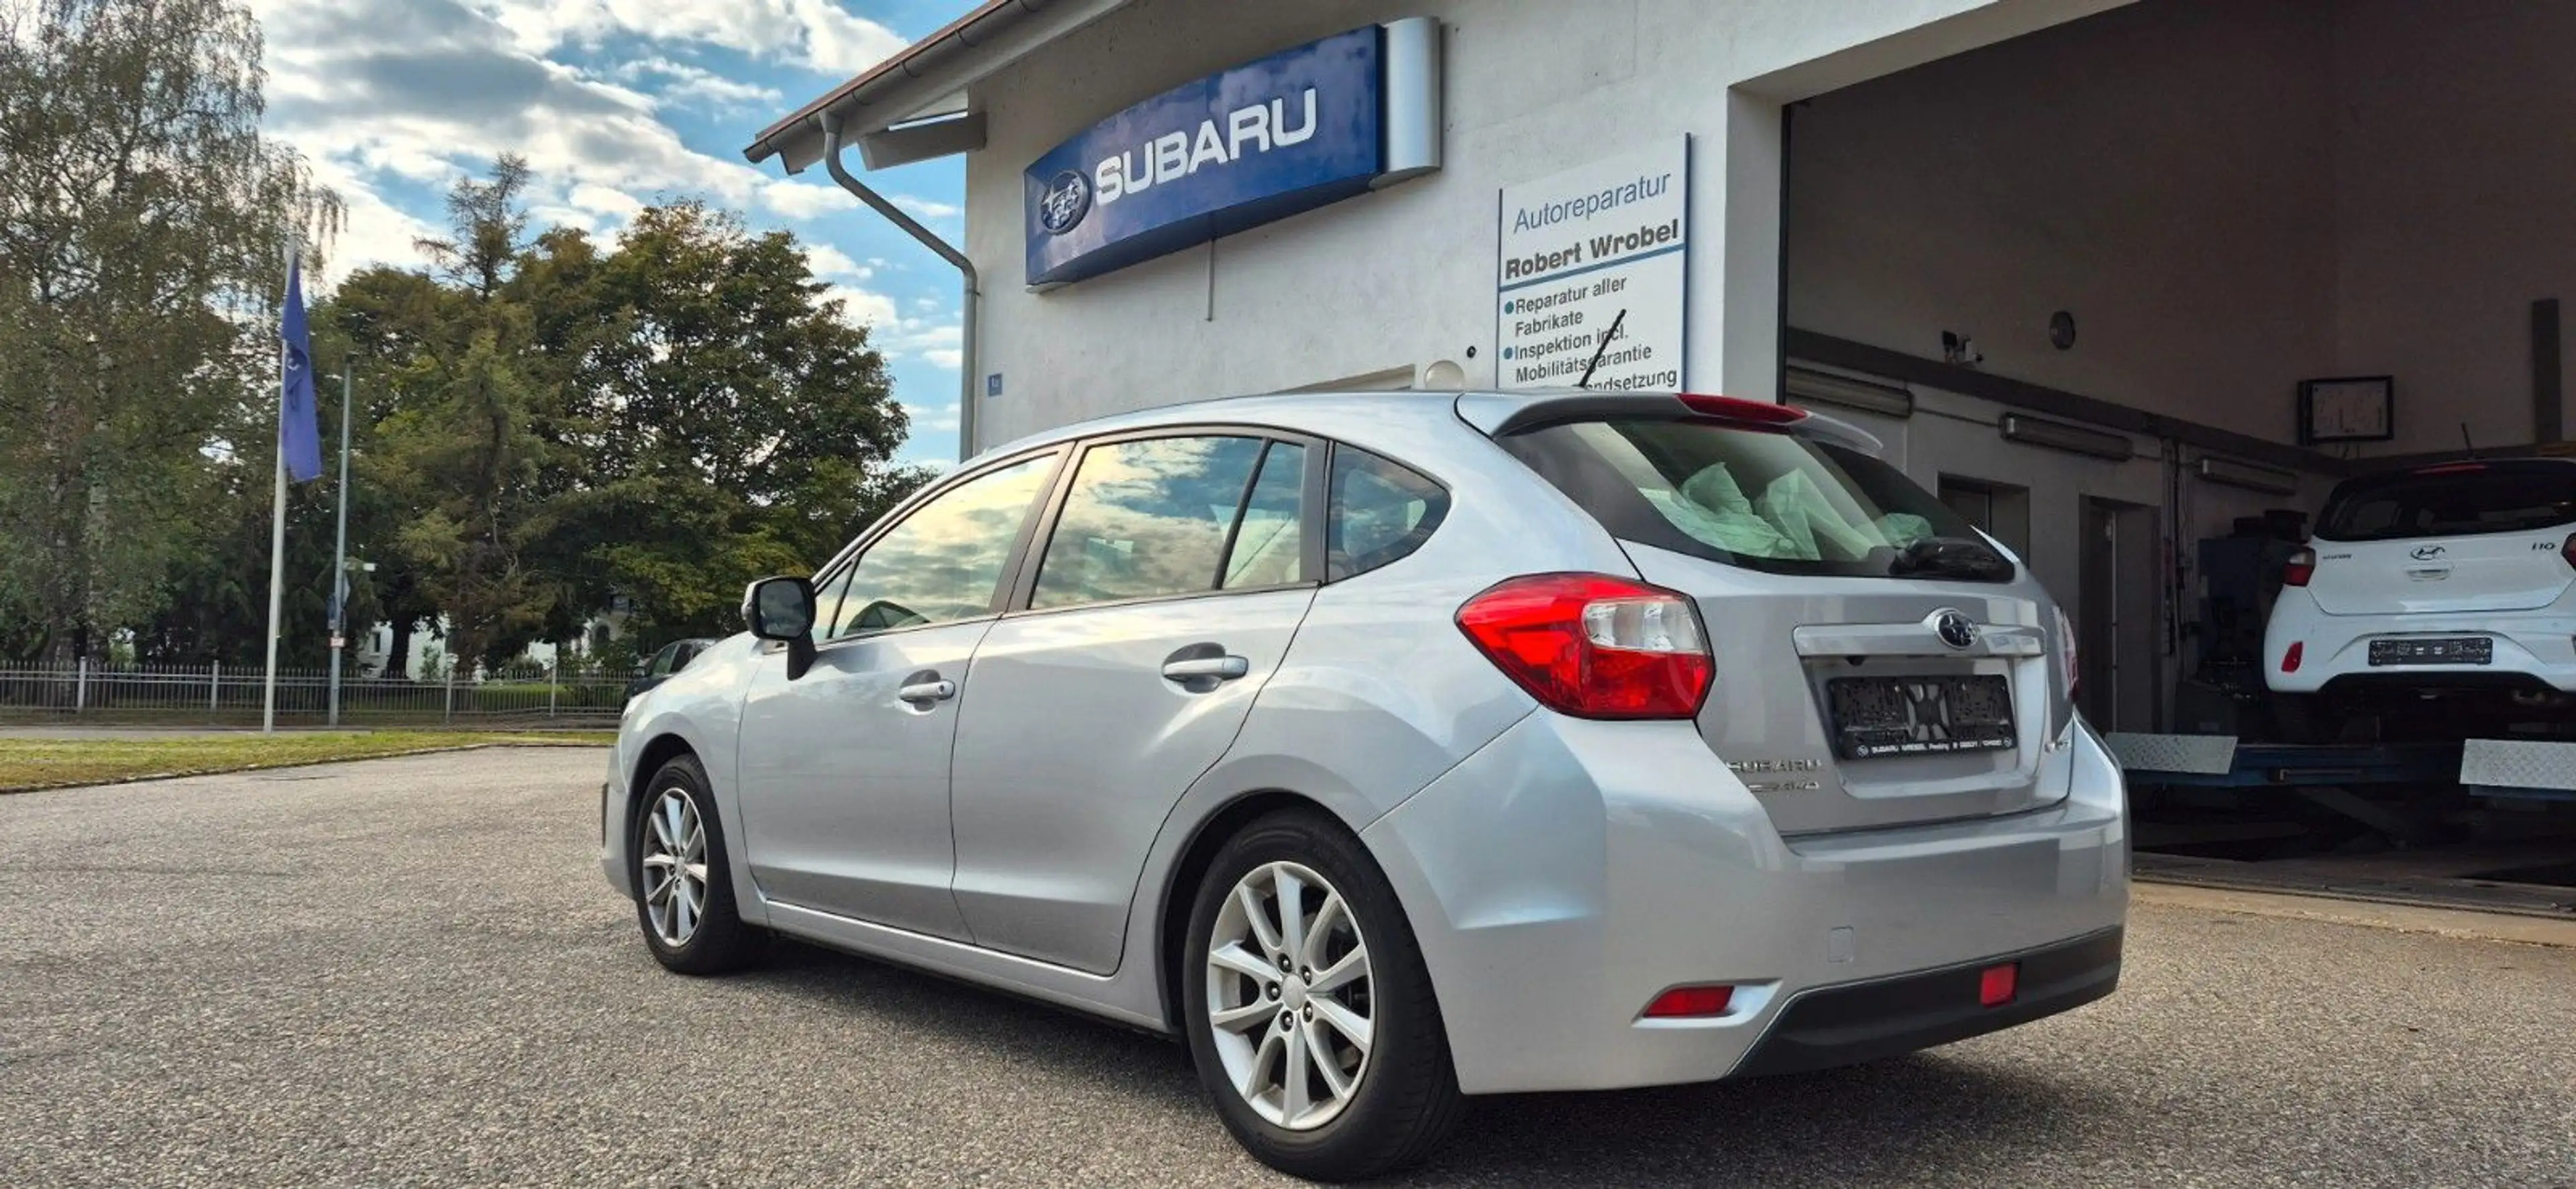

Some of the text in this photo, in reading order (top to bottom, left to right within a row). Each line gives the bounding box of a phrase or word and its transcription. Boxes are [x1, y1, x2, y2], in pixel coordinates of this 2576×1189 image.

[1095, 88, 1318, 206] SUBARU
[1514, 172, 1671, 234] Autoreparatur
[1505, 219, 1678, 280] Robert Wrobel
[1516, 276, 1627, 313] Reparatur aller
[1515, 311, 1584, 337] Fabrikate
[1515, 334, 1592, 361] Inspektion
